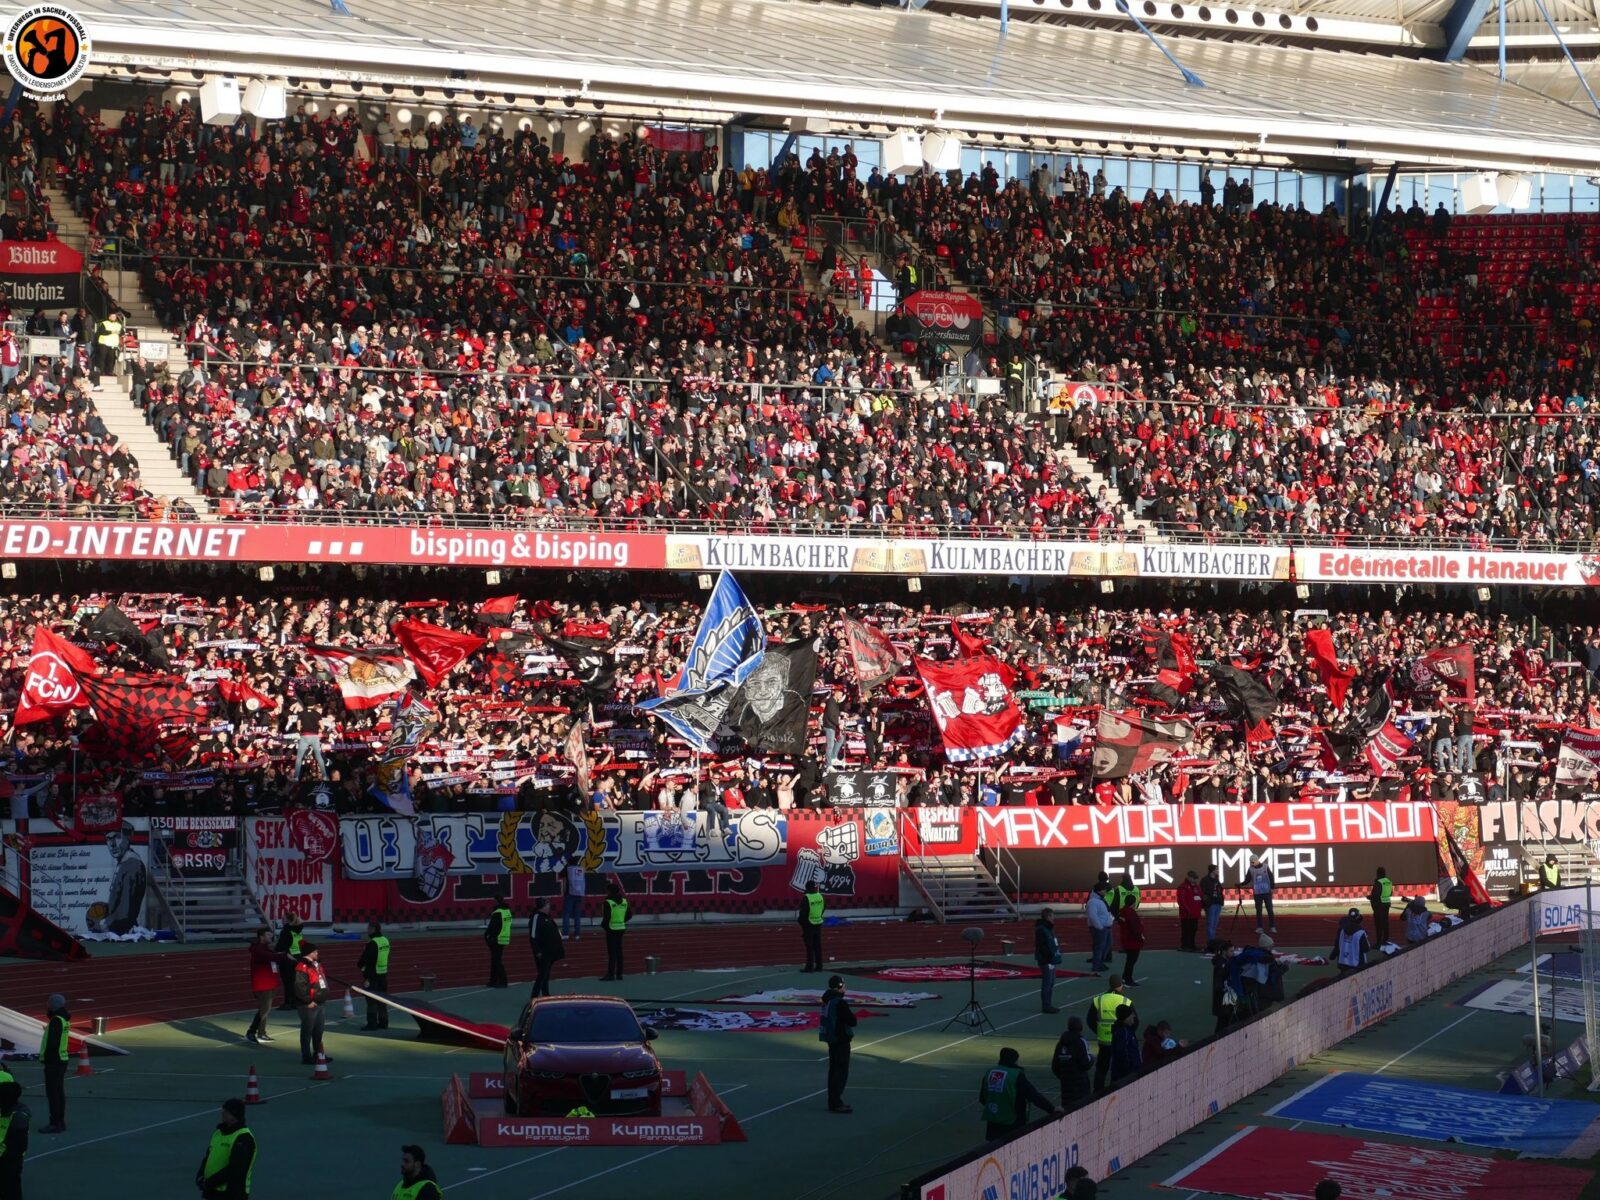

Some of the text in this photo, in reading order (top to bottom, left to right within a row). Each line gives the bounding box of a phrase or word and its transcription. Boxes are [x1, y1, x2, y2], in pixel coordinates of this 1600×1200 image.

[8, 246, 57, 267] Böhse
[935, 313, 953, 322] FCN
[0, 524, 246, 557] ED-INTERNET
[410, 530, 506, 563] bisping
[511, 533, 532, 558] &
[535, 533, 629, 566] bisping
[707, 538, 849, 568] KULMBACHER
[931, 542, 1065, 573] KULMBACHER
[1143, 547, 1271, 576] KULMBACHER
[1319, 552, 1568, 581] Edelmetalle Hanauer
[26, 671, 72, 700] FCN
[1560, 757, 1594, 772] 1312
[175, 816, 190, 830] DIE
[918, 806, 961, 823] RESPEKT
[978, 801, 1438, 847] MAX-MORLOCK-STADION
[919, 824, 959, 842] RIVALITÄT
[184, 853, 213, 868] RSR
[1103, 847, 1174, 886] FÜR
[1484, 858, 1518, 871] WILL LIVE
[1492, 848, 1509, 860] YOU
[256, 857, 323, 885] STADION
[828, 875, 851, 887] 1994
[1544, 903, 1583, 929] SOLAR
